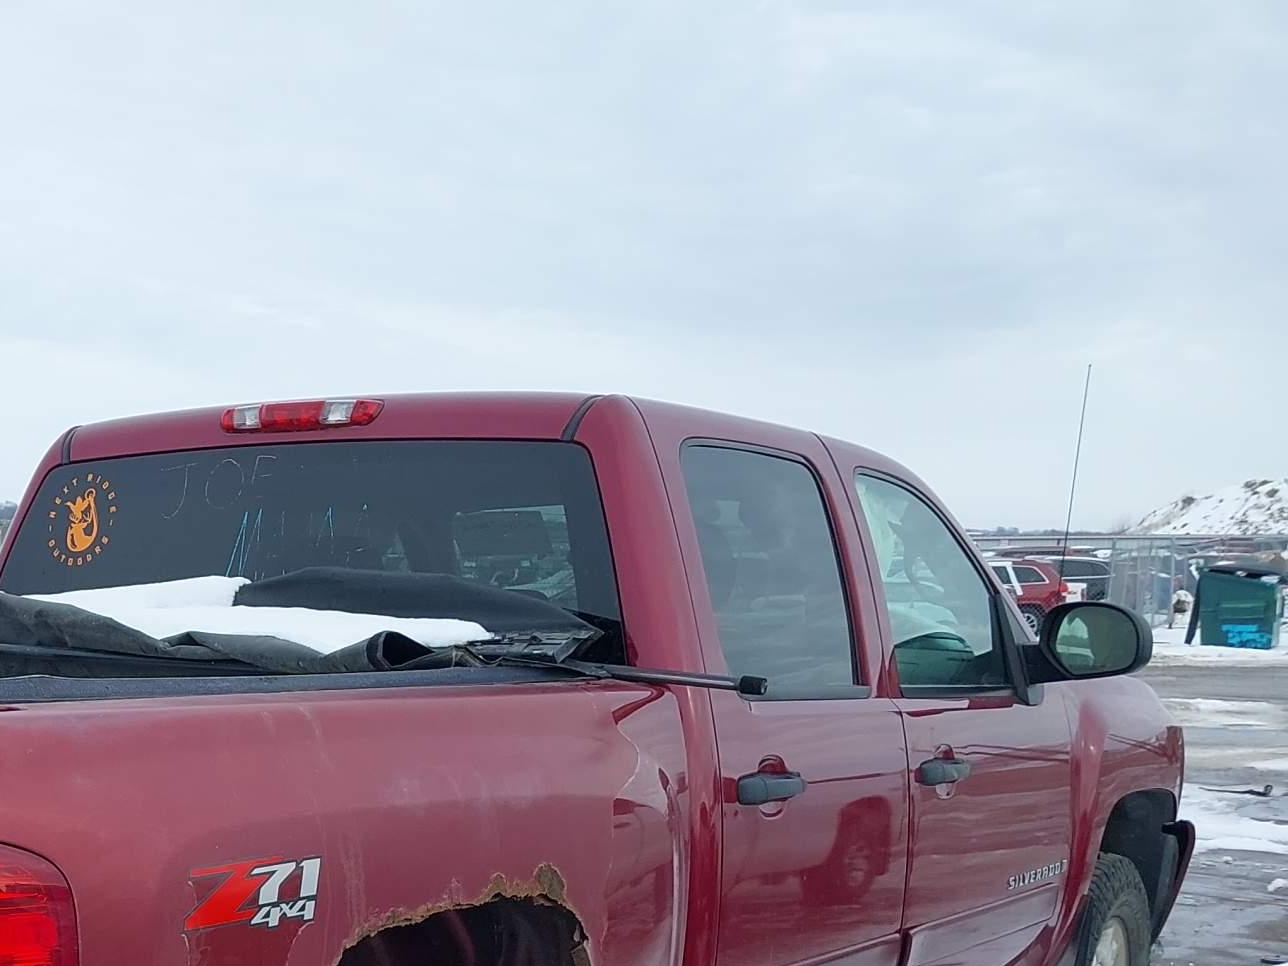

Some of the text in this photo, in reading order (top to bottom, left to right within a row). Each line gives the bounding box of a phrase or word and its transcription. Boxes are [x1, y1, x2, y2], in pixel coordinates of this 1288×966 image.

[47, 532, 110, 567] OUTDOORS
[1007, 861, 1061, 890] SILVERADO
[184, 856, 322, 931] Z71
